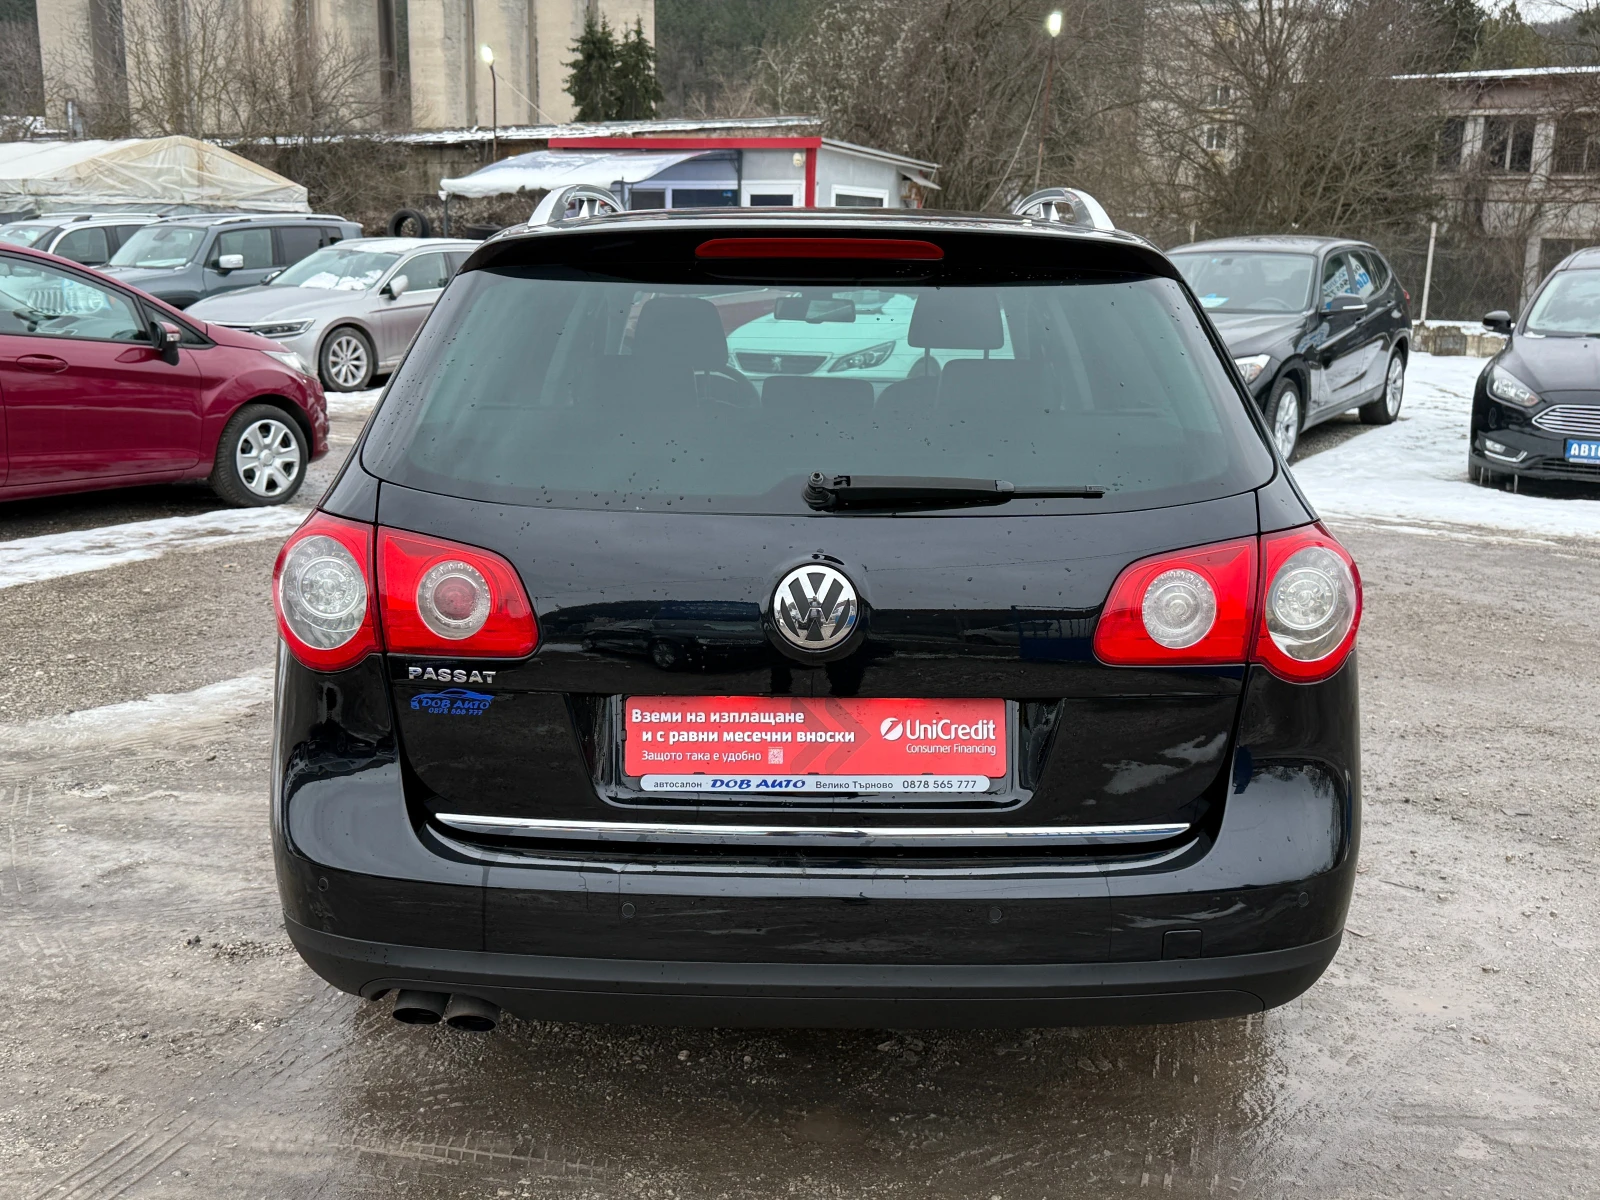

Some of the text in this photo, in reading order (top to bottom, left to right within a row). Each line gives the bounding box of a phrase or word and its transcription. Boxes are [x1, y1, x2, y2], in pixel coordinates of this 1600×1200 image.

[408, 666, 497, 684] PASSAT
[421, 698, 490, 710] DOB AUTO
[631, 708, 805, 726] Вземи на изплащане
[905, 718, 996, 740] UniCredit
[642, 730, 855, 746] и с равни месечни вноски
[641, 750, 762, 763] Защото така е удобно
[906, 743, 997, 756] Consumer Financing
[653, 778, 978, 791] автосалон DOB AUTO Велико Търново 0878 565 777
